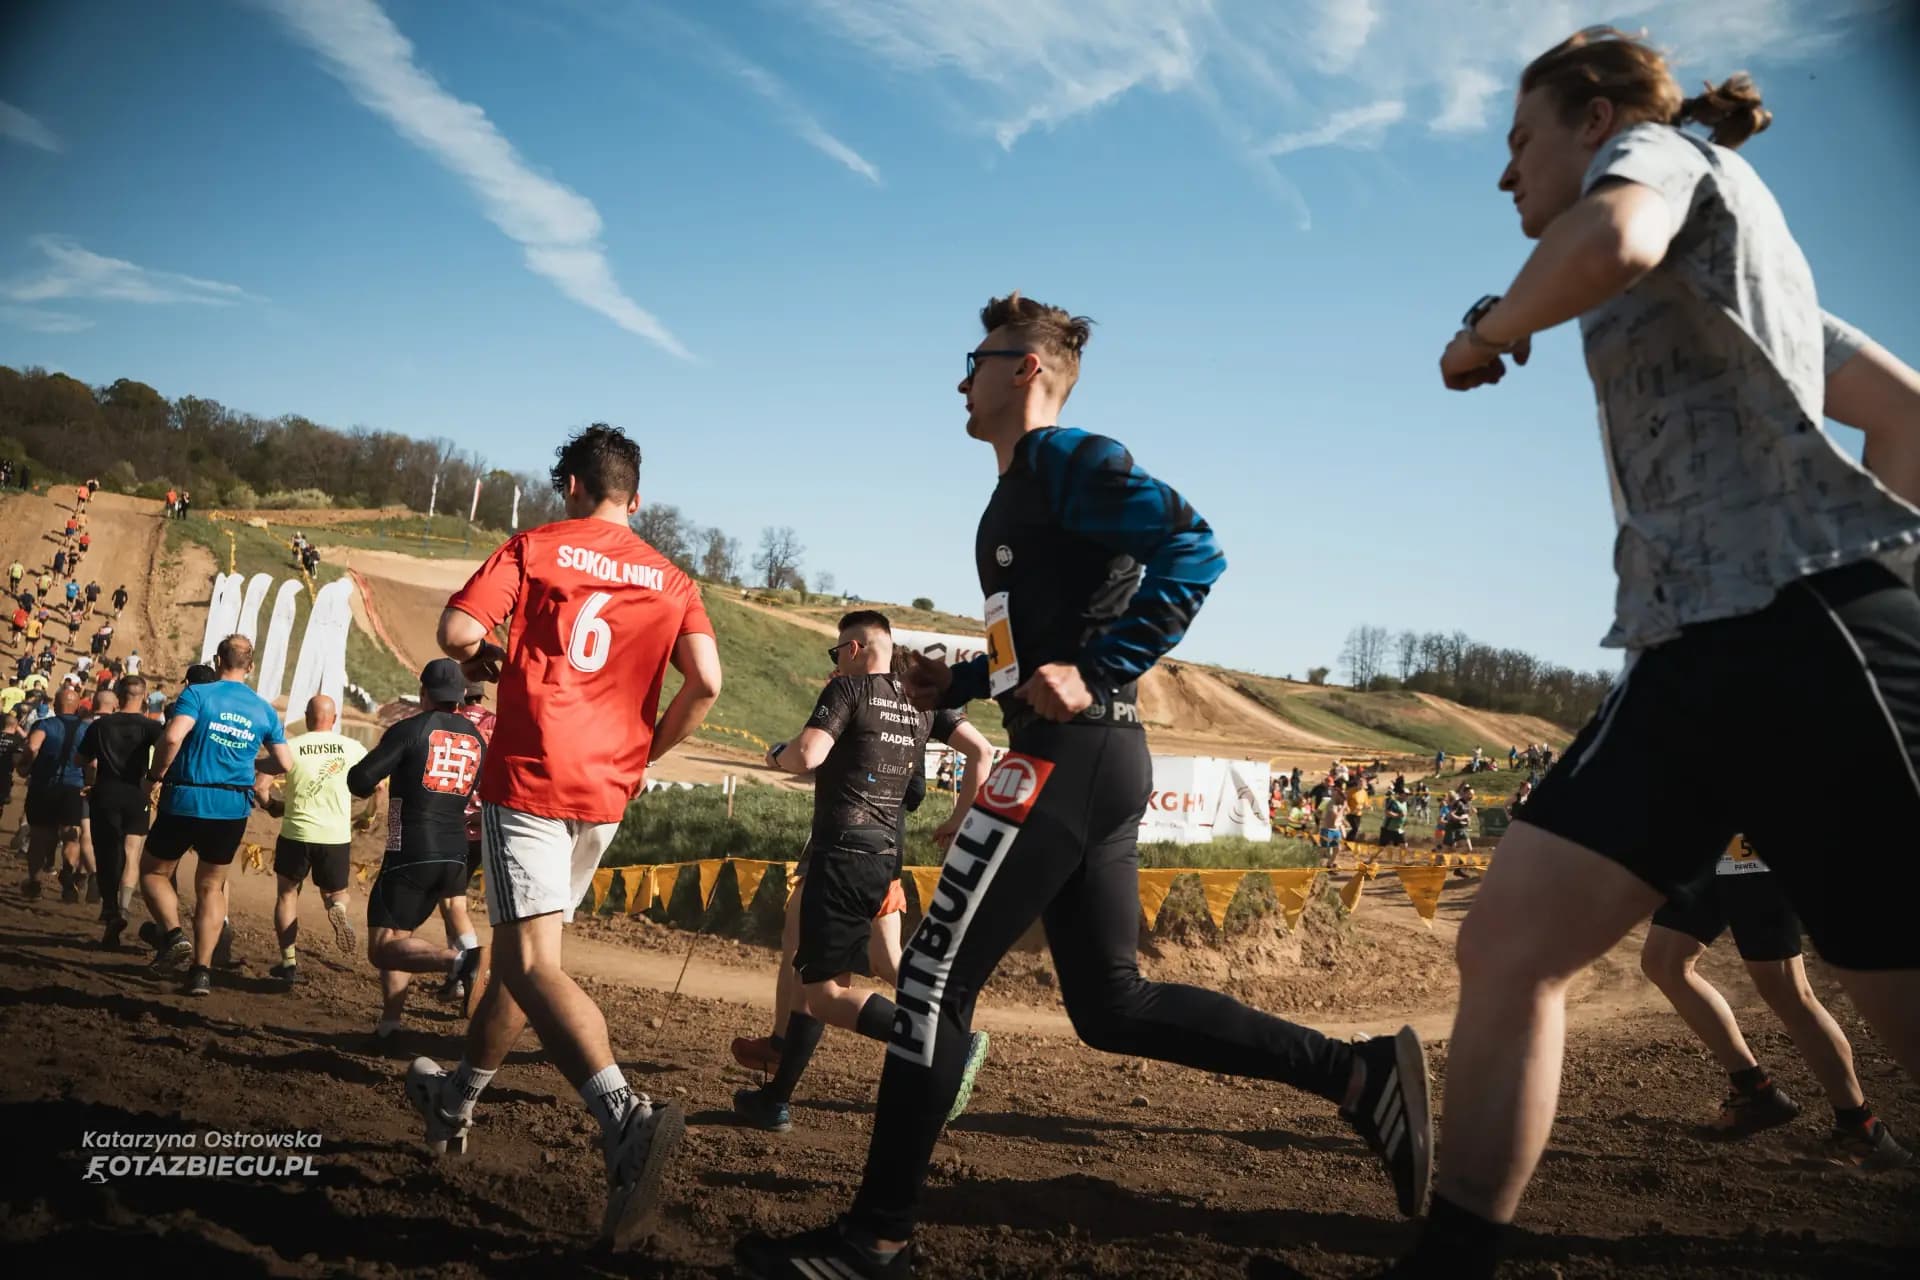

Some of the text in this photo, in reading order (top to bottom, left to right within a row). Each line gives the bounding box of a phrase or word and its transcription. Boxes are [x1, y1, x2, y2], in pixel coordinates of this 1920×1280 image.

[557, 545, 664, 591] SOKOLNIKI
[567, 592, 612, 673] 6
[219, 712, 252, 728] GRUPA
[209, 733, 248, 749] SZCZECIN
[880, 732, 915, 746] RADEK
[299, 743, 345, 755] KRZYSIEK
[877, 763, 907, 776] LEGNICA
[1740, 840, 1753, 857] 5
[889, 828, 1005, 1056] PITBULL
